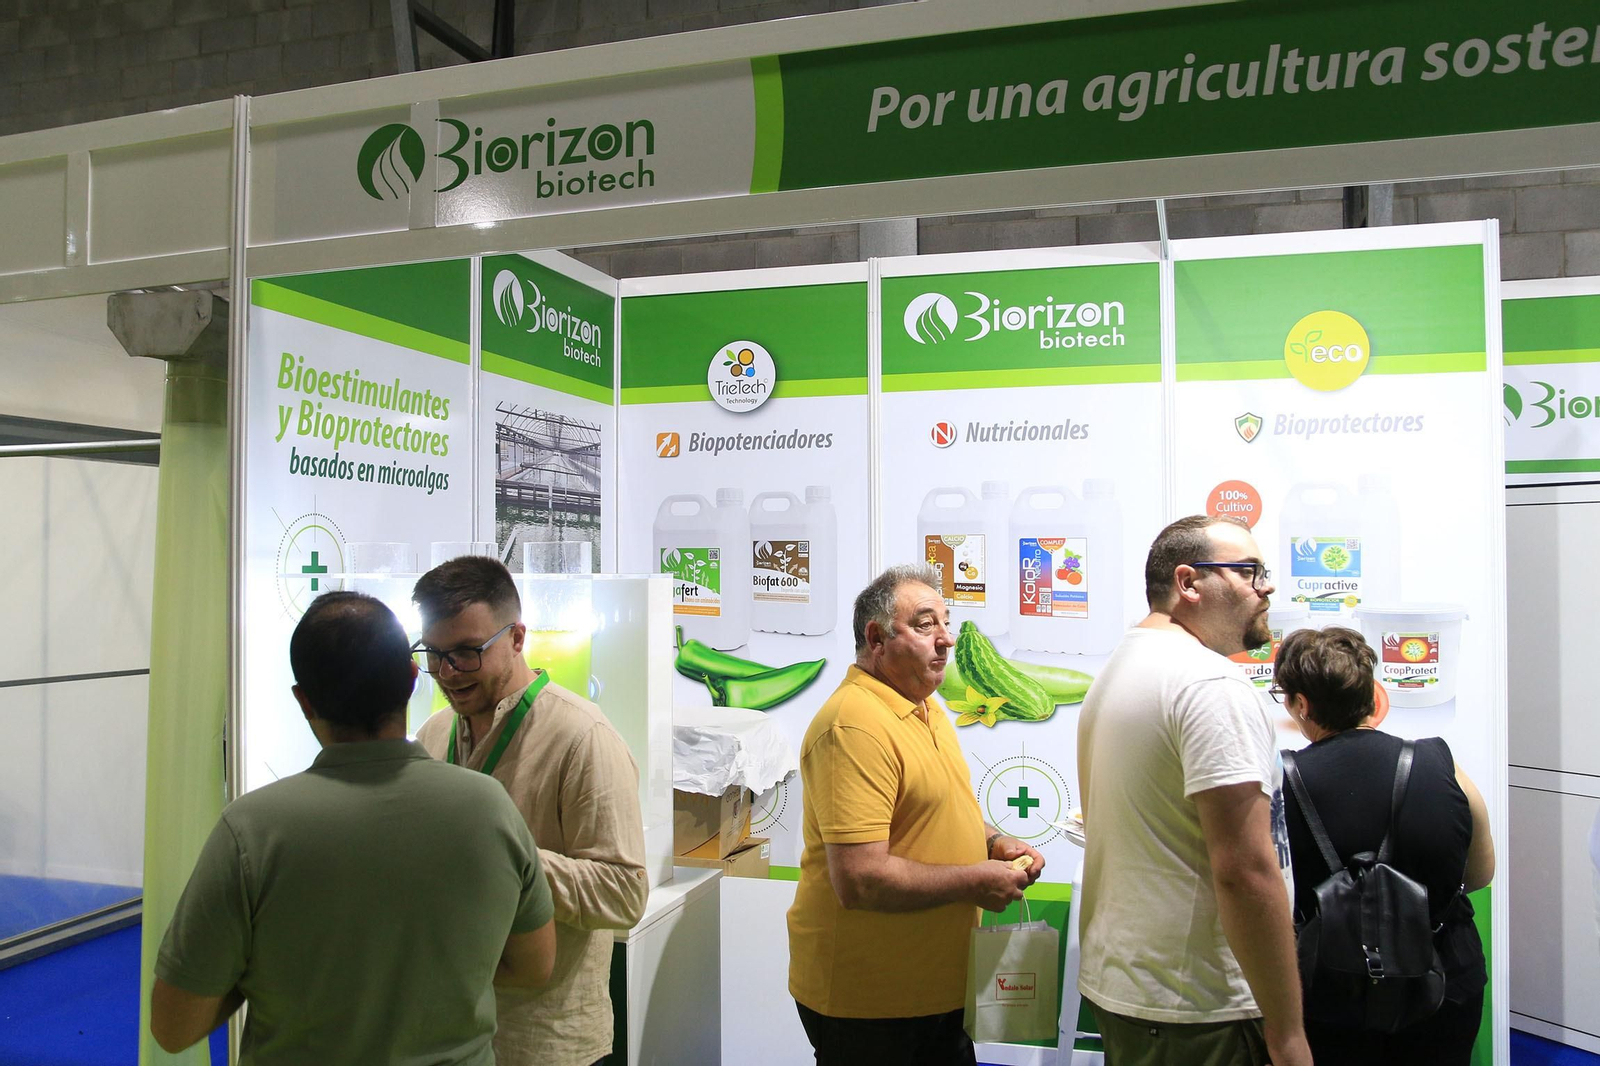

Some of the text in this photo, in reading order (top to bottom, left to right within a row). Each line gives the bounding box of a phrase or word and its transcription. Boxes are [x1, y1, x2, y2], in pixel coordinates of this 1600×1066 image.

[866, 86, 956, 133] Por
[966, 78, 1067, 121] una
[1082, 42, 1403, 122] agricultura
[435, 117, 655, 193] Biorizon
[537, 160, 655, 199] biotech
[526, 279, 602, 350] Biorizon
[964, 291, 1125, 341] Biorizon
[1040, 327, 1125, 349] biotech
[563, 338, 602, 367] biotech
[1311, 344, 1363, 363] eco
[277, 352, 450, 421] Bioestimulantes
[275, 399, 450, 457] y Bioprotectores
[966, 419, 1090, 443] Nutricionales
[1273, 413, 1425, 440] Bioprotectores
[688, 429, 834, 456] Biopotenciadores
[289, 446, 450, 495] basados en microalgas
[1215, 502, 1254, 513] Cultivo
[1219, 490, 1248, 500] 100%
[753, 575, 780, 591] Biofat
[780, 577, 798, 587] 600
[1297, 578, 1359, 592] Cupractive
[1384, 665, 1437, 676] CropProtect
